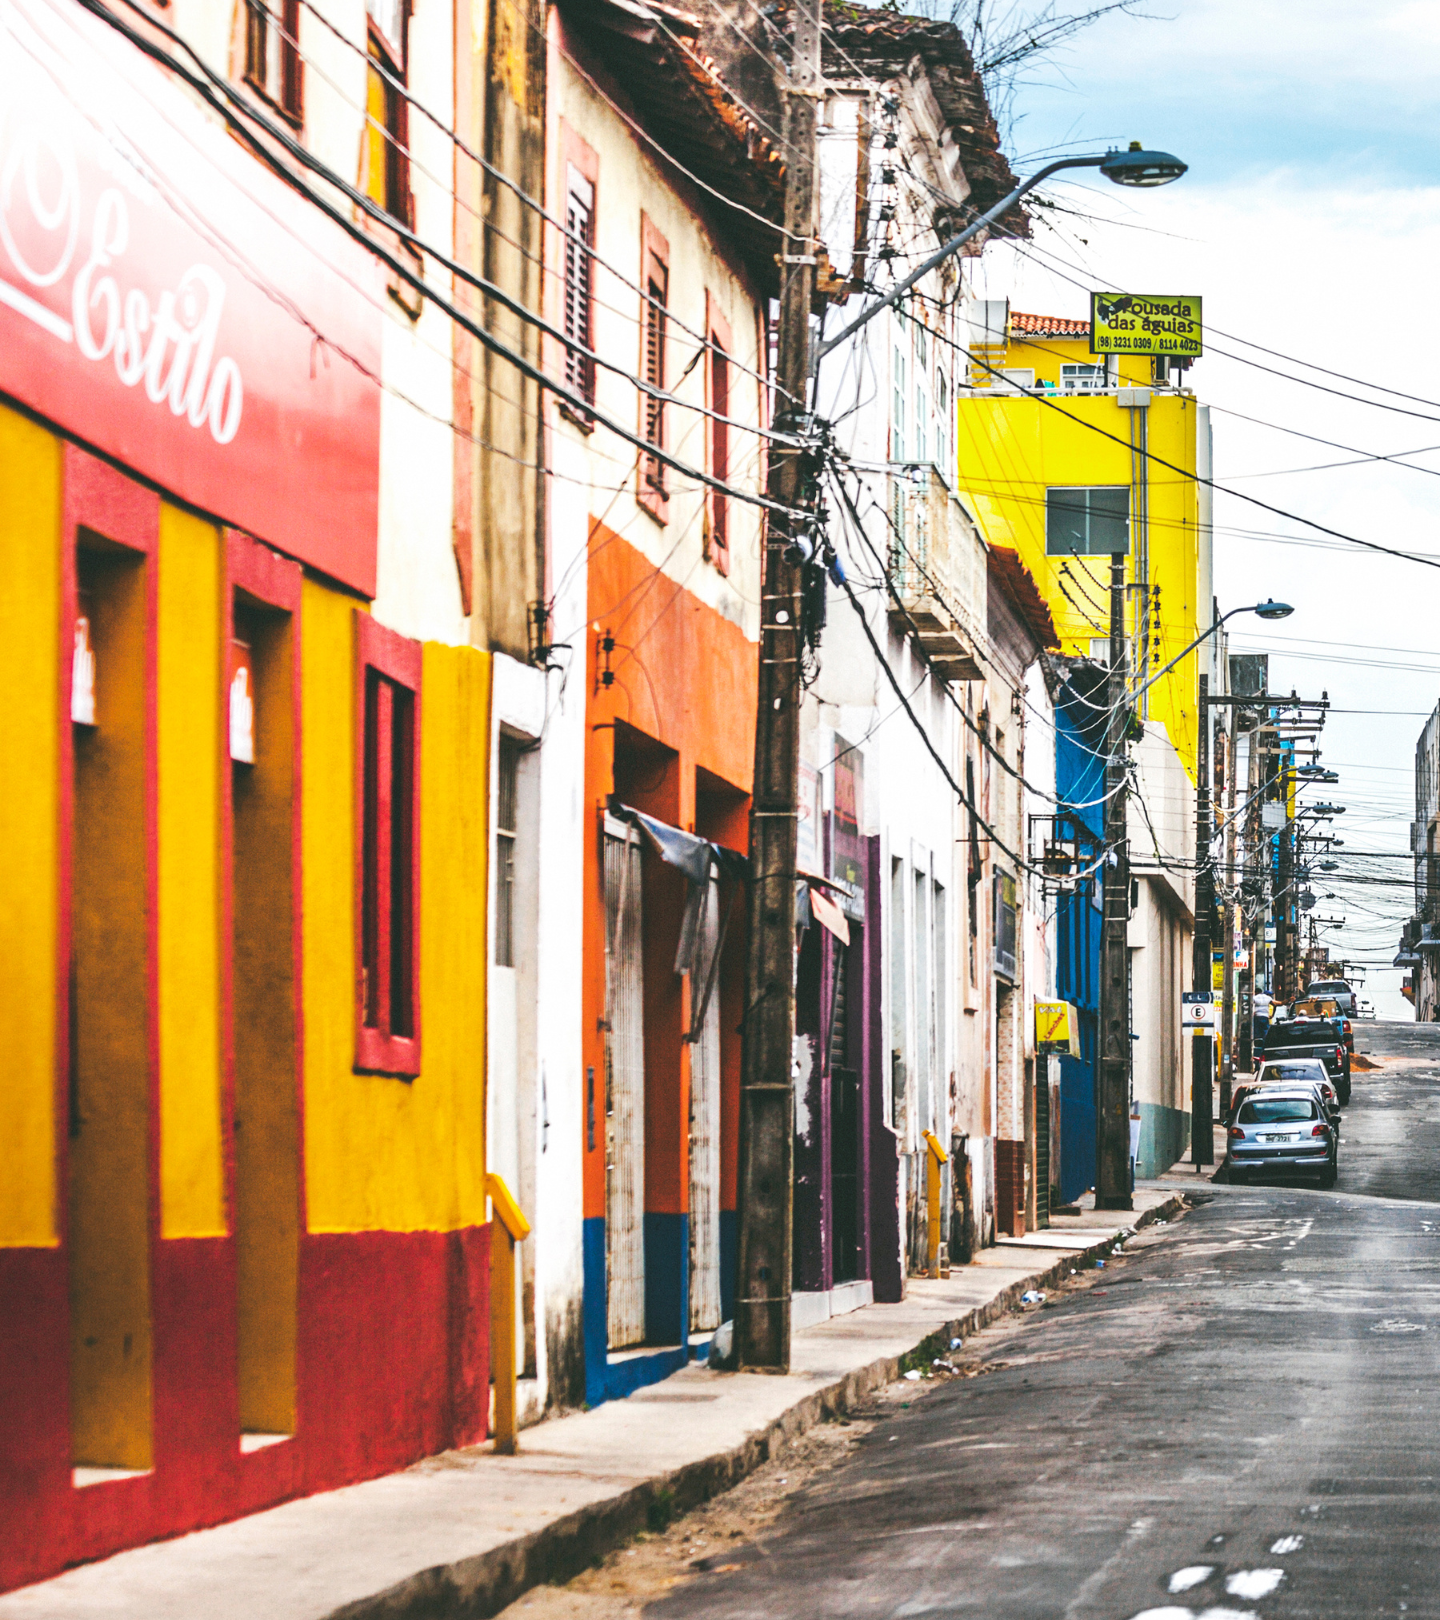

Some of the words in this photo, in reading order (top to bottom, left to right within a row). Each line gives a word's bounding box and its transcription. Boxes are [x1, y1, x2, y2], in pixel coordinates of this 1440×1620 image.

[72, 188, 243, 445] Estilo
[1108, 315, 1136, 330] das
[1141, 316, 1194, 336] águias
[1097, 336, 1111, 349] (98)
[1113, 336, 1131, 348] 3231
[1133, 337, 1151, 349] 0309
[1159, 338, 1177, 350] 8114
[1179, 339, 1198, 351] 4023
[1038, 1006, 1063, 1014] VAL
[1195, 1007, 1201, 1017] E
[1044, 1012, 1065, 1039] Lanches
